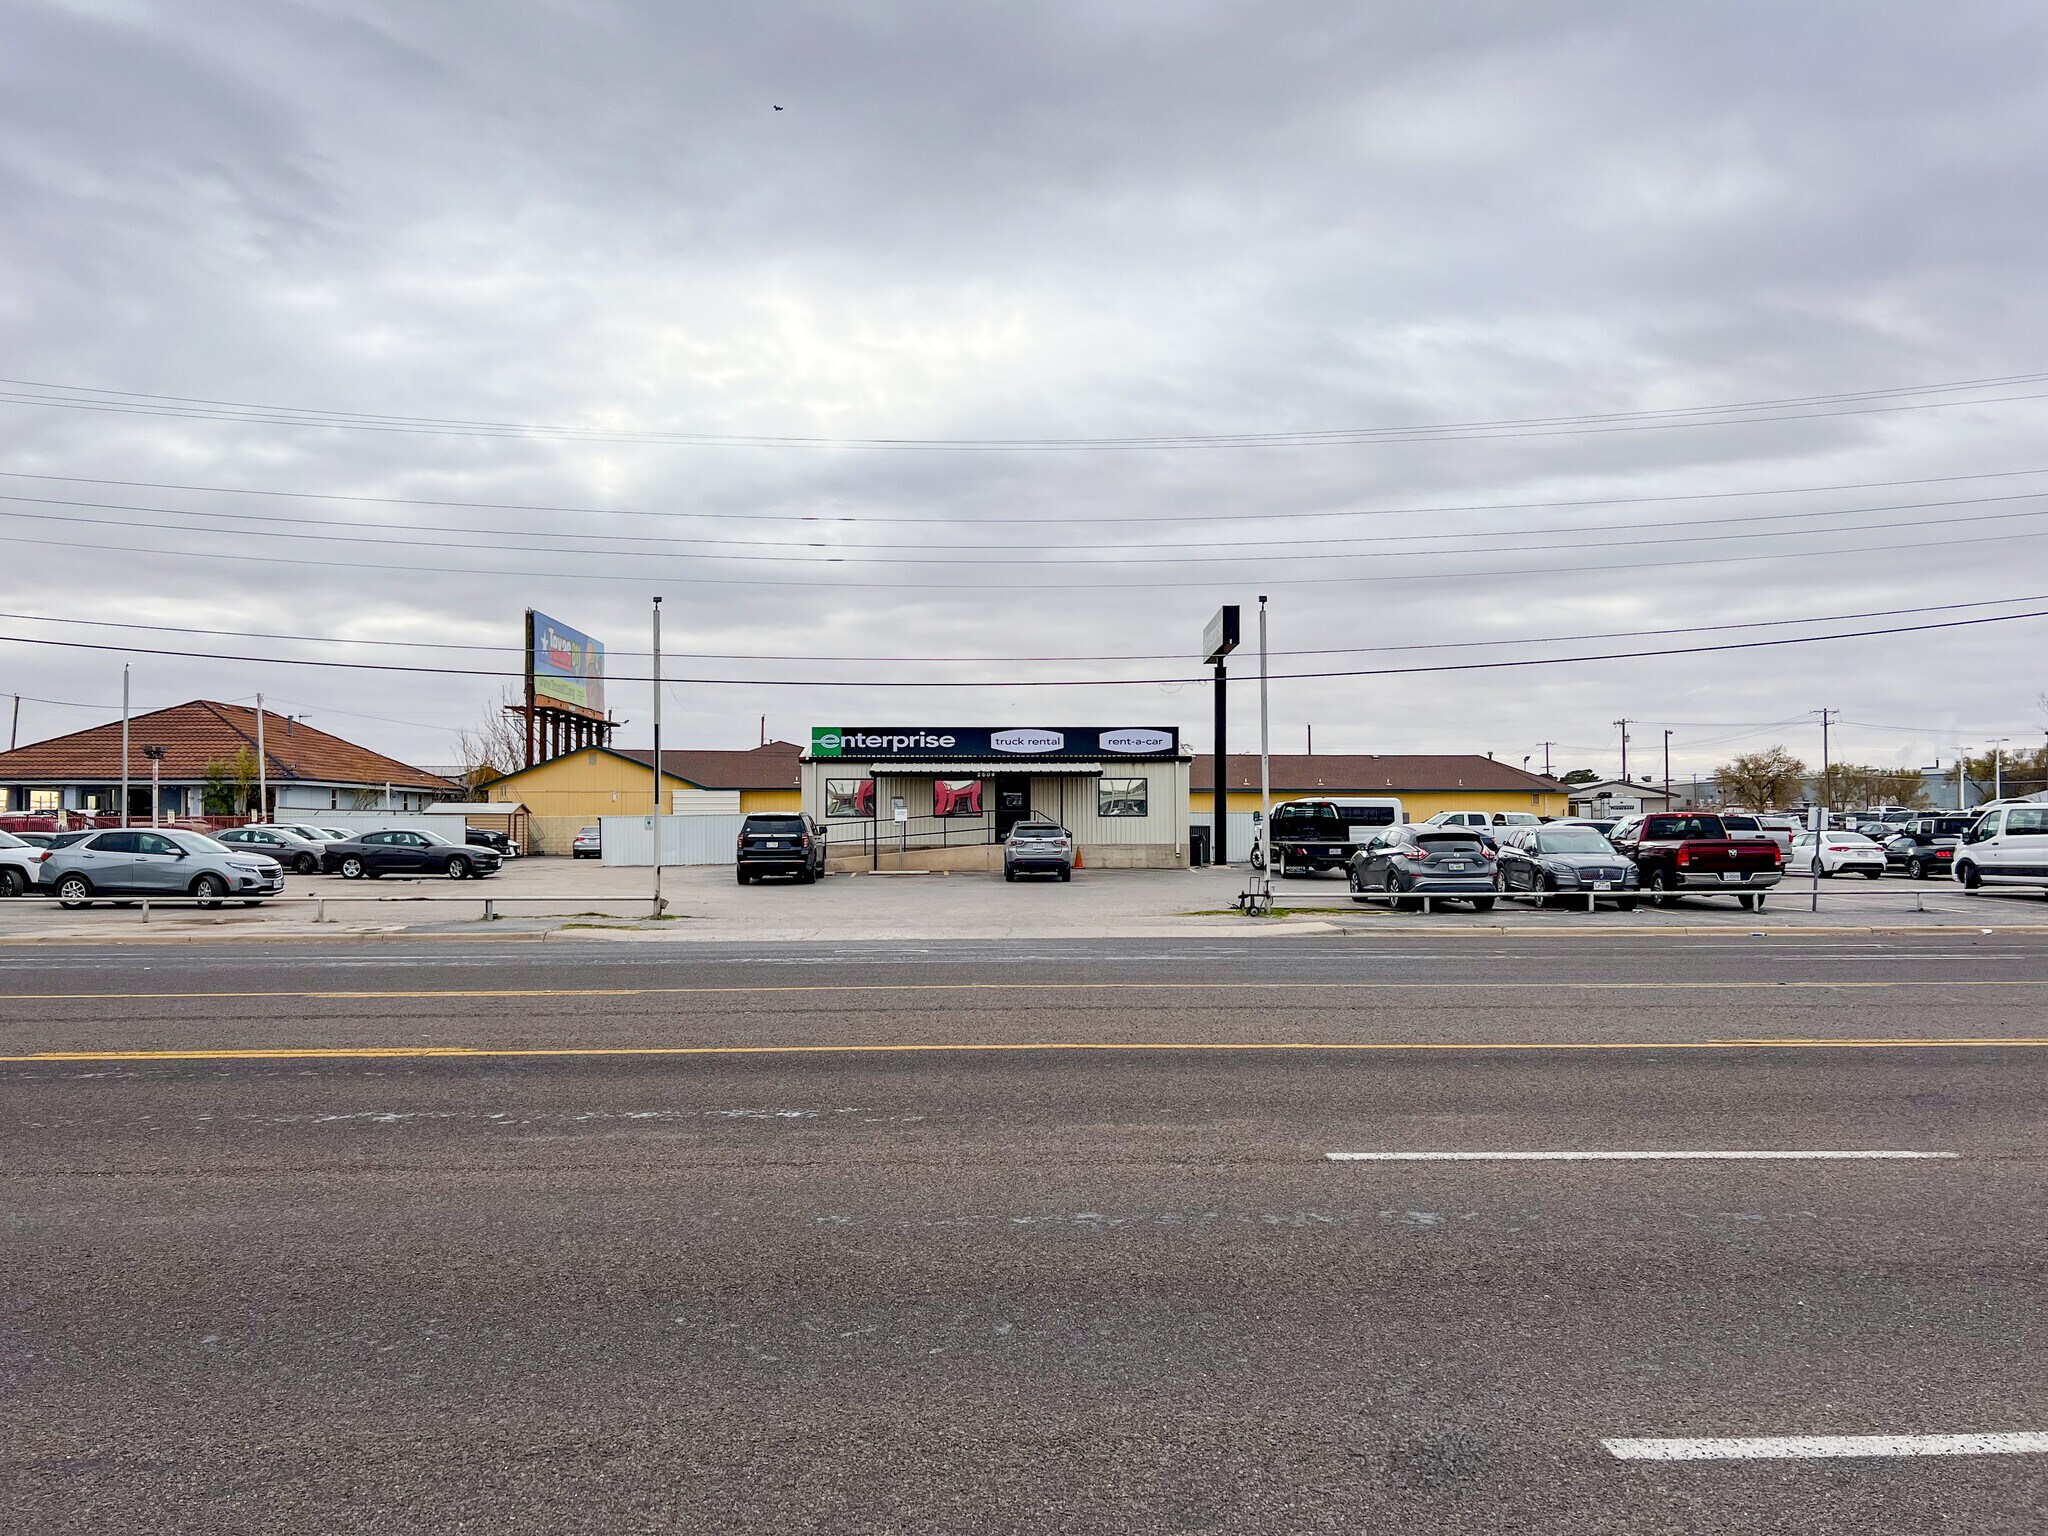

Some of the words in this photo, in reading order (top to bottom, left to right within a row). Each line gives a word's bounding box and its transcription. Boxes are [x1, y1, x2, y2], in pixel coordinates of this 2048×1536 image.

[820, 731, 956, 752] enterprise
[995, 737, 1024, 746] truck
[1028, 737, 1061, 746] rental
[1108, 738, 1163, 746] rent-a-car
